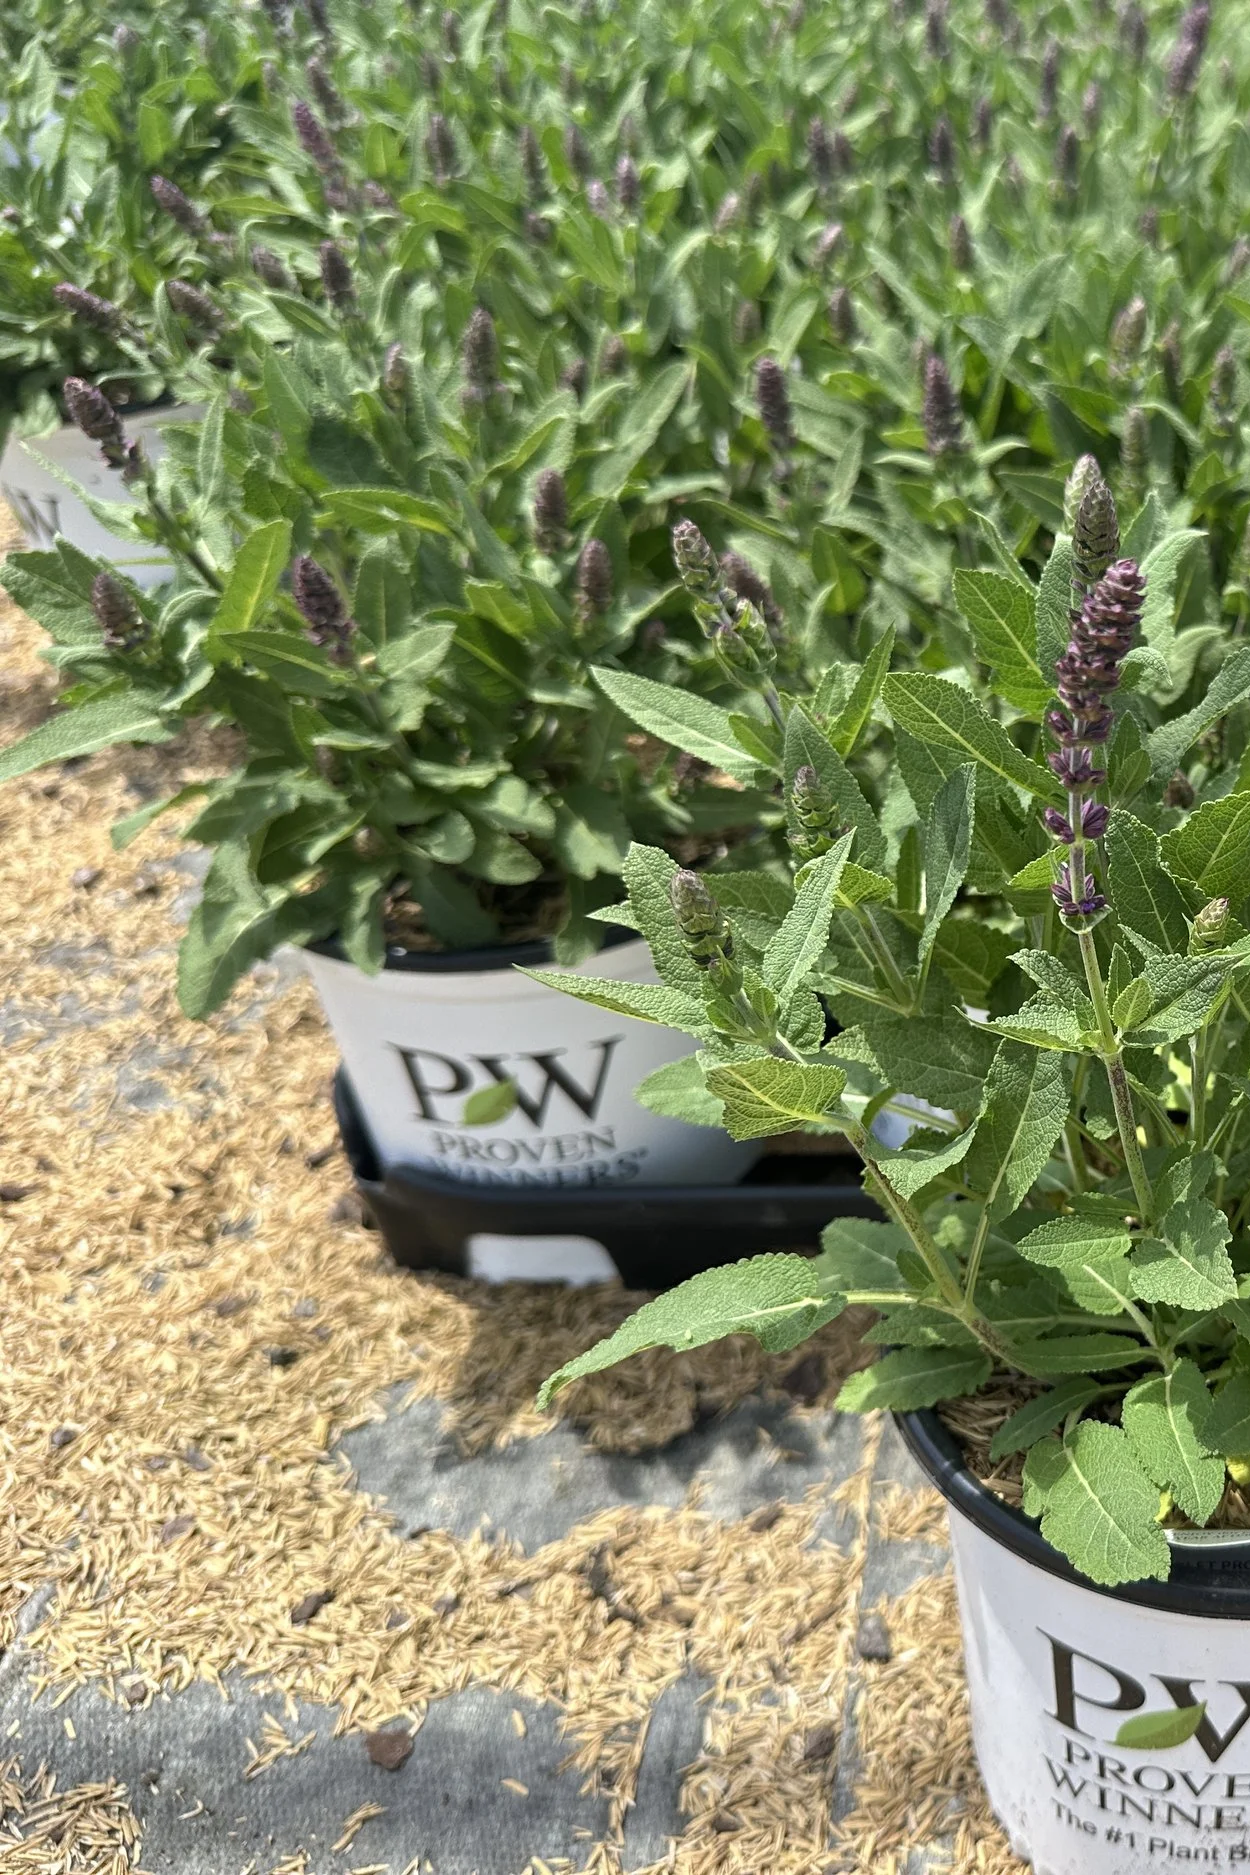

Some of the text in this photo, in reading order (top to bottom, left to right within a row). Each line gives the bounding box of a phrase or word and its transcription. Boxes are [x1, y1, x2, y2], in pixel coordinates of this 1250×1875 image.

[383, 1033, 625, 1130] PW
[429, 1126, 617, 1167] PROVEN
[1051, 1797, 1098, 1836] The
[1105, 1824, 1136, 1849] #1
[1148, 1836, 1219, 1862] Plant
